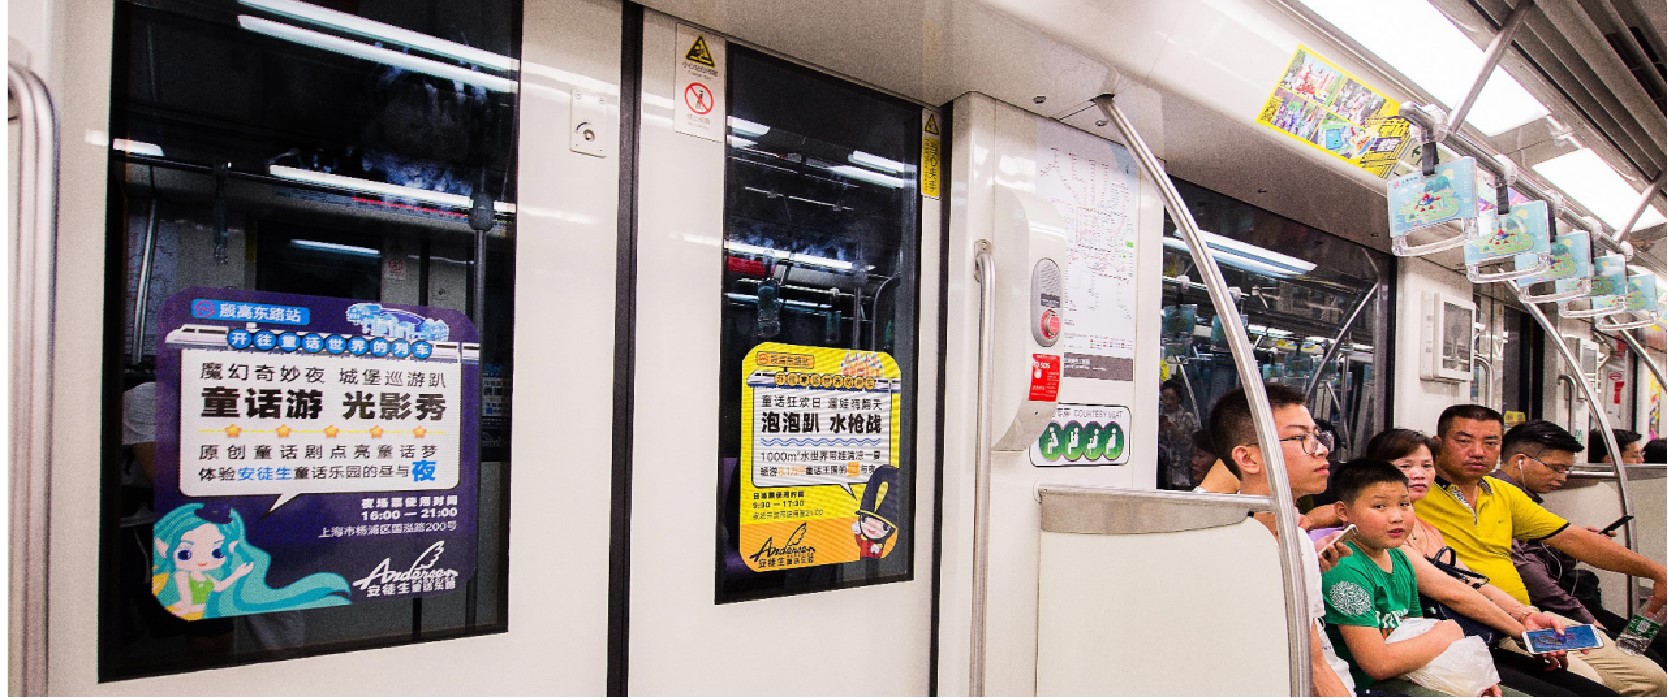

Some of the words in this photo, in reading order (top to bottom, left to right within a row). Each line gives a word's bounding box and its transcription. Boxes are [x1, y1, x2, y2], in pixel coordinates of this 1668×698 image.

[219, 303, 301, 322] 殷高东路站
[230, 331, 430, 357] 开往童话世界的列车
[200, 362, 326, 383] 魔幻奇妙夜
[339, 367, 447, 389] 城堡巡游趴
[200, 385, 323, 420] 童话游
[343, 391, 447, 421] 光影秀
[761, 394, 821, 409] 童话狂欢日
[761, 411, 820, 434] 泡泡趴
[829, 413, 883, 434] 水枪战
[199, 444, 438, 461] 原创童话剧点亮童话梦
[199, 459, 437, 483] 体验安徒生童话乐园的昼与夜
[361, 509, 401, 521] 16:00
[420, 507, 458, 519] 21:00
